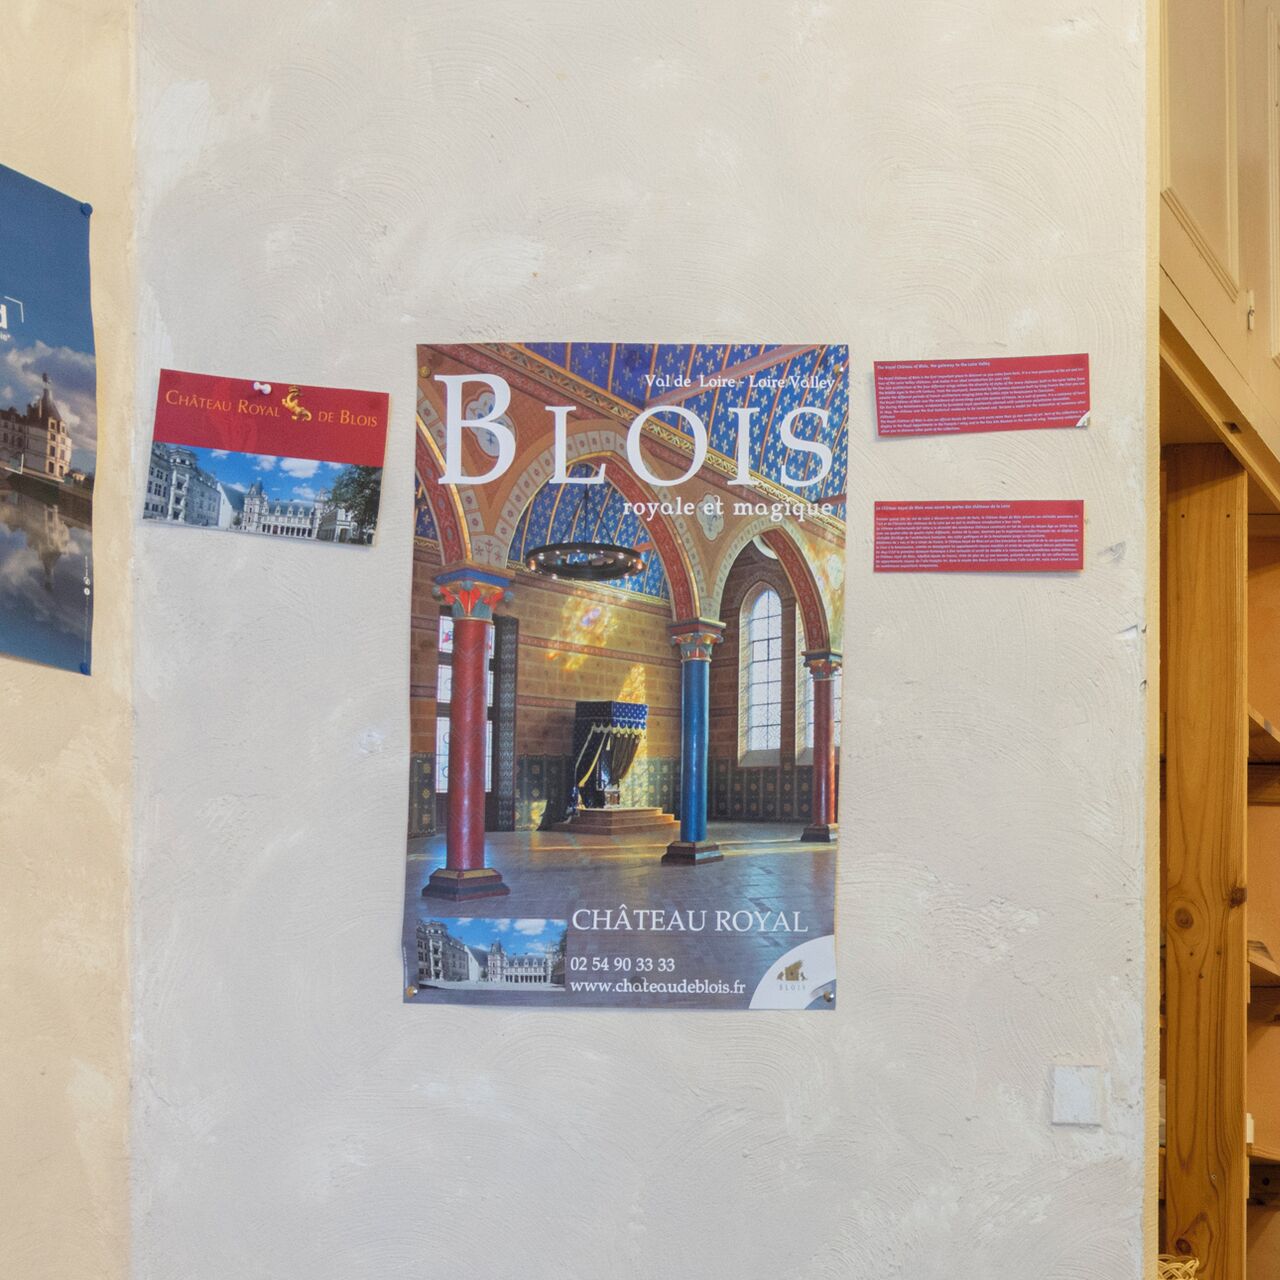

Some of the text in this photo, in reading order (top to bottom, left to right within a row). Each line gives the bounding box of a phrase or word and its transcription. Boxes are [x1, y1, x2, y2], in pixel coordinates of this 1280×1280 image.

[645, 374, 671, 388] Val
[674, 374, 691, 388] de
[700, 375, 736, 388] Loire
[749, 375, 785, 388] Loire
[789, 375, 835, 391] Valley
[166, 390, 232, 412] CHÂTEAU
[238, 400, 280, 418] ROYAL
[340, 410, 378, 427] BLOIS
[434, 373, 833, 487] BLOIS
[623, 497, 834, 522] royale et magique
[572, 904, 809, 933] CHÂTEAU ROYAL
[570, 957, 675, 973] 02 54 90 33 33
[570, 978, 746, 994] www.chateaudeblois.fr
